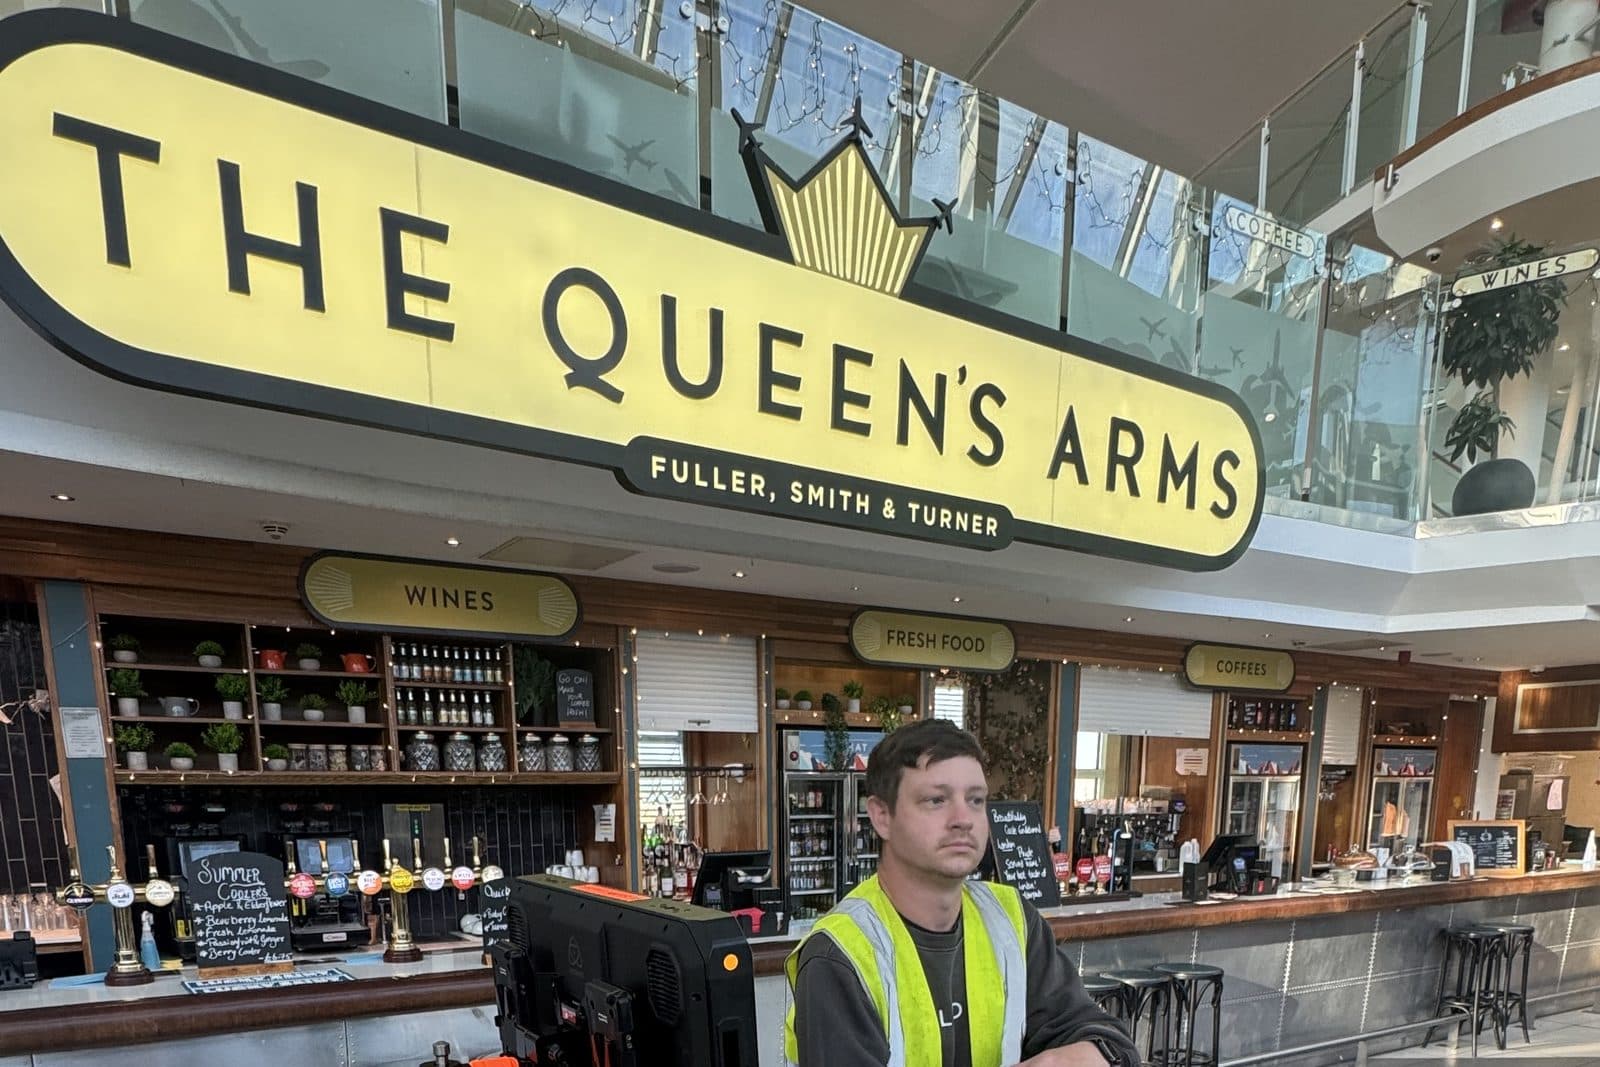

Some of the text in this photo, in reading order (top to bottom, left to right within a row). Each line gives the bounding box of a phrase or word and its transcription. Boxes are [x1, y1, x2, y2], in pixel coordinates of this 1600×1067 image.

[1236, 211, 1304, 253] COFFEE
[1480, 255, 1568, 290] WINES
[52, 111, 1242, 520] THE QUEEN'S ARMS
[651, 455, 999, 538] FULLER, SMITH & TURNER
[404, 584, 495, 612] WINES
[887, 629, 986, 653] FRESH FOOD
[1216, 660, 1267, 676] COFFEES
[197, 859, 261, 885] SUMMER
[204, 901, 234, 914] Apple
[205, 926, 235, 938] Fresh
[208, 948, 237, 960] Berry
